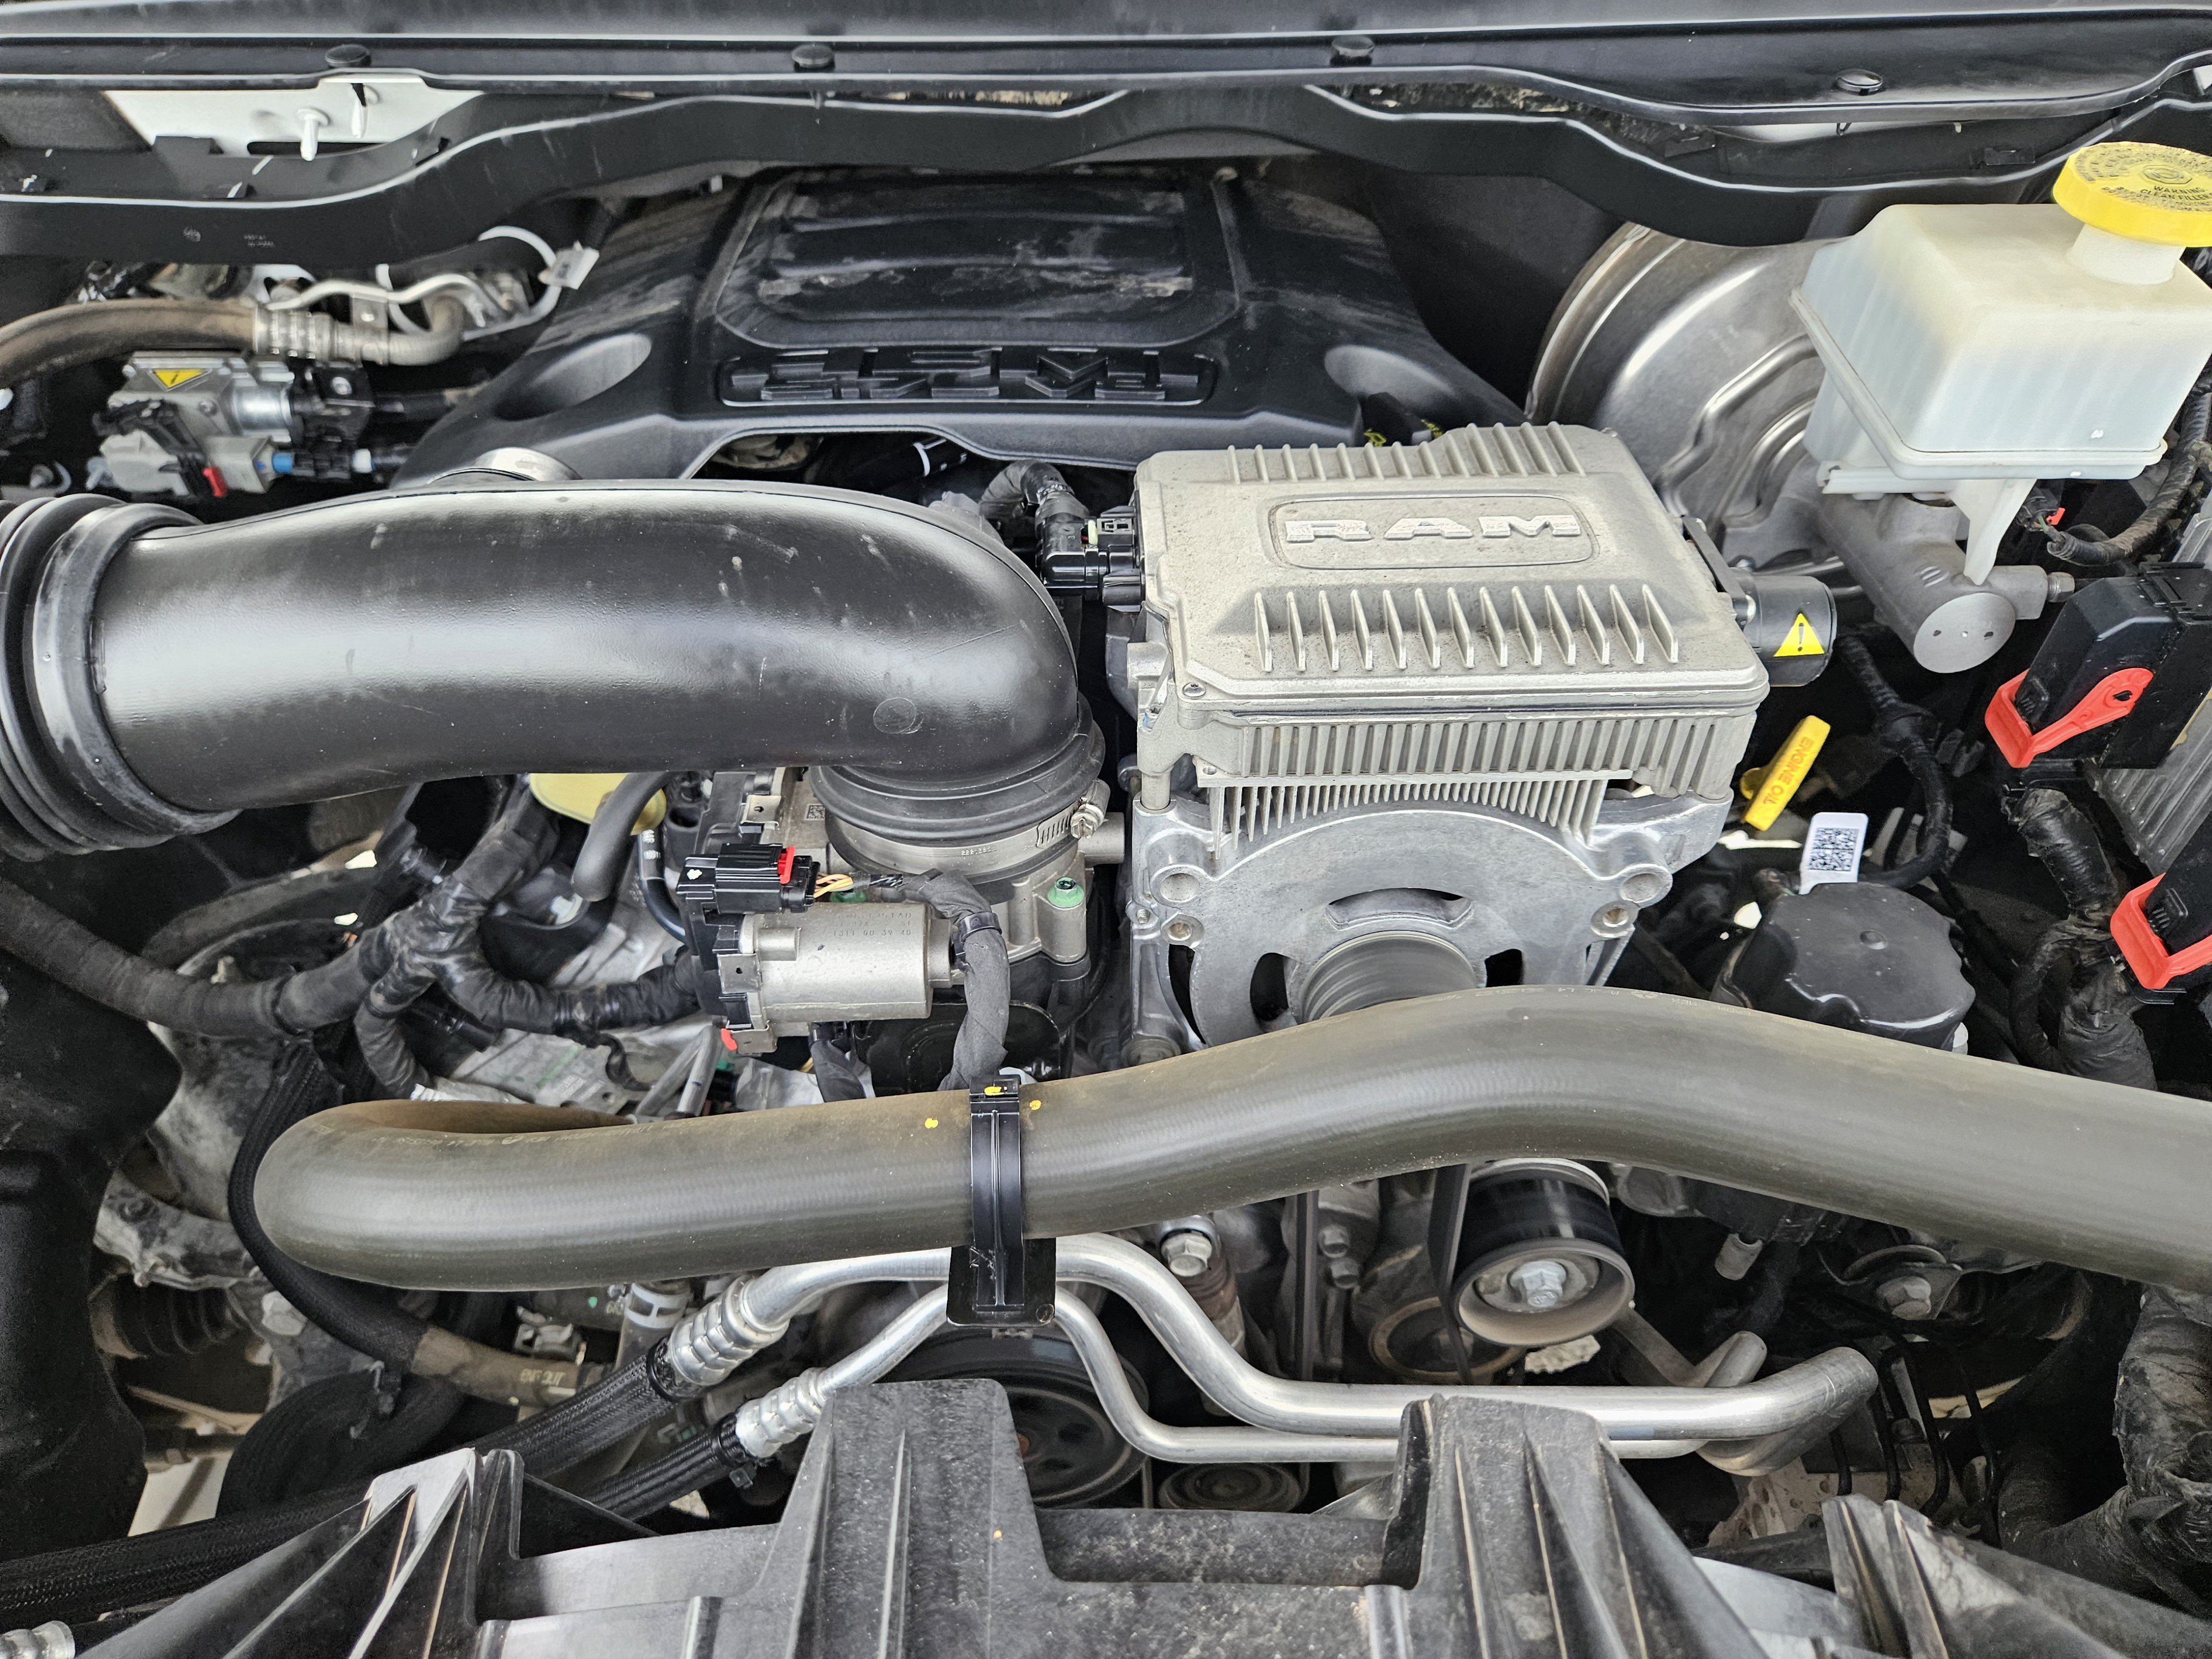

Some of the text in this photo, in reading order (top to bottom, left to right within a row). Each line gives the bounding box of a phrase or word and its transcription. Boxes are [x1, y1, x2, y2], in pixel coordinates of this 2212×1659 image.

[2141, 189, 2176, 199] CLEAN
[1285, 515, 1582, 543] RAM
[1762, 736, 1815, 805] ENGINE OIL
